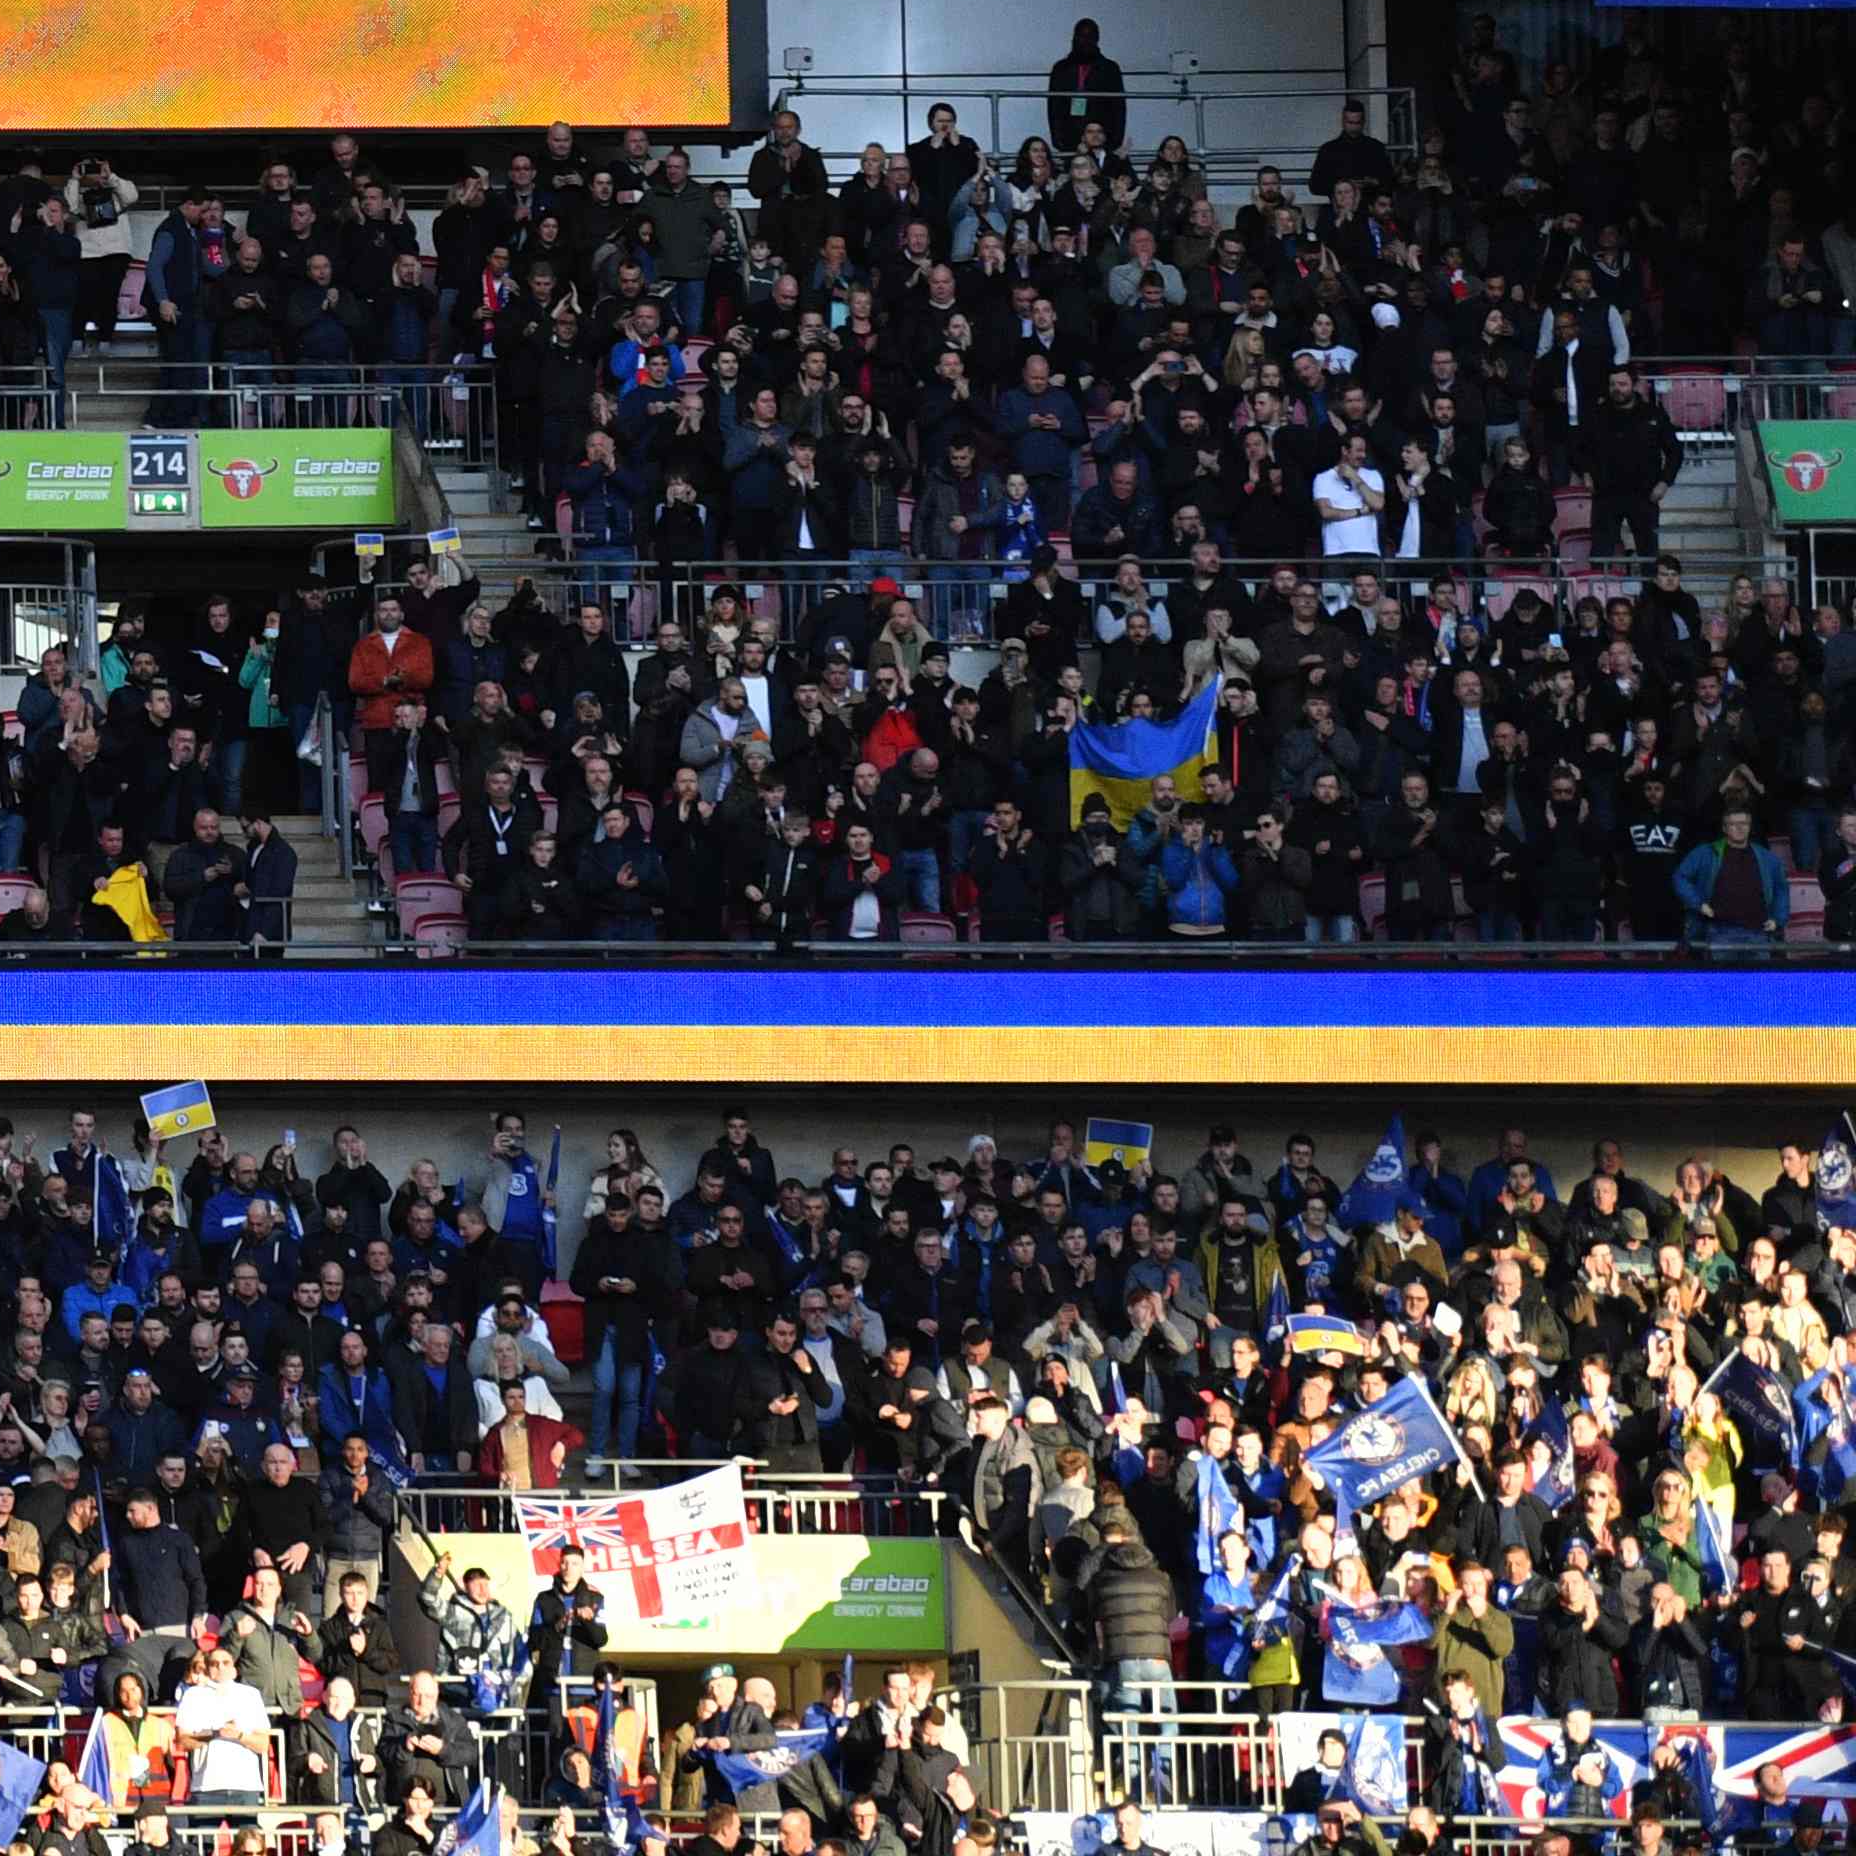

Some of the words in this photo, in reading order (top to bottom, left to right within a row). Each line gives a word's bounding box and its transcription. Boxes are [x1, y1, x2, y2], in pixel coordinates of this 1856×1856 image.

[27, 462, 114, 481] Carabao
[133, 451, 187, 476] 214
[293, 457, 381, 476] Carabao
[26, 489, 73, 502] ENERGY
[1629, 824, 1682, 848] EA7
